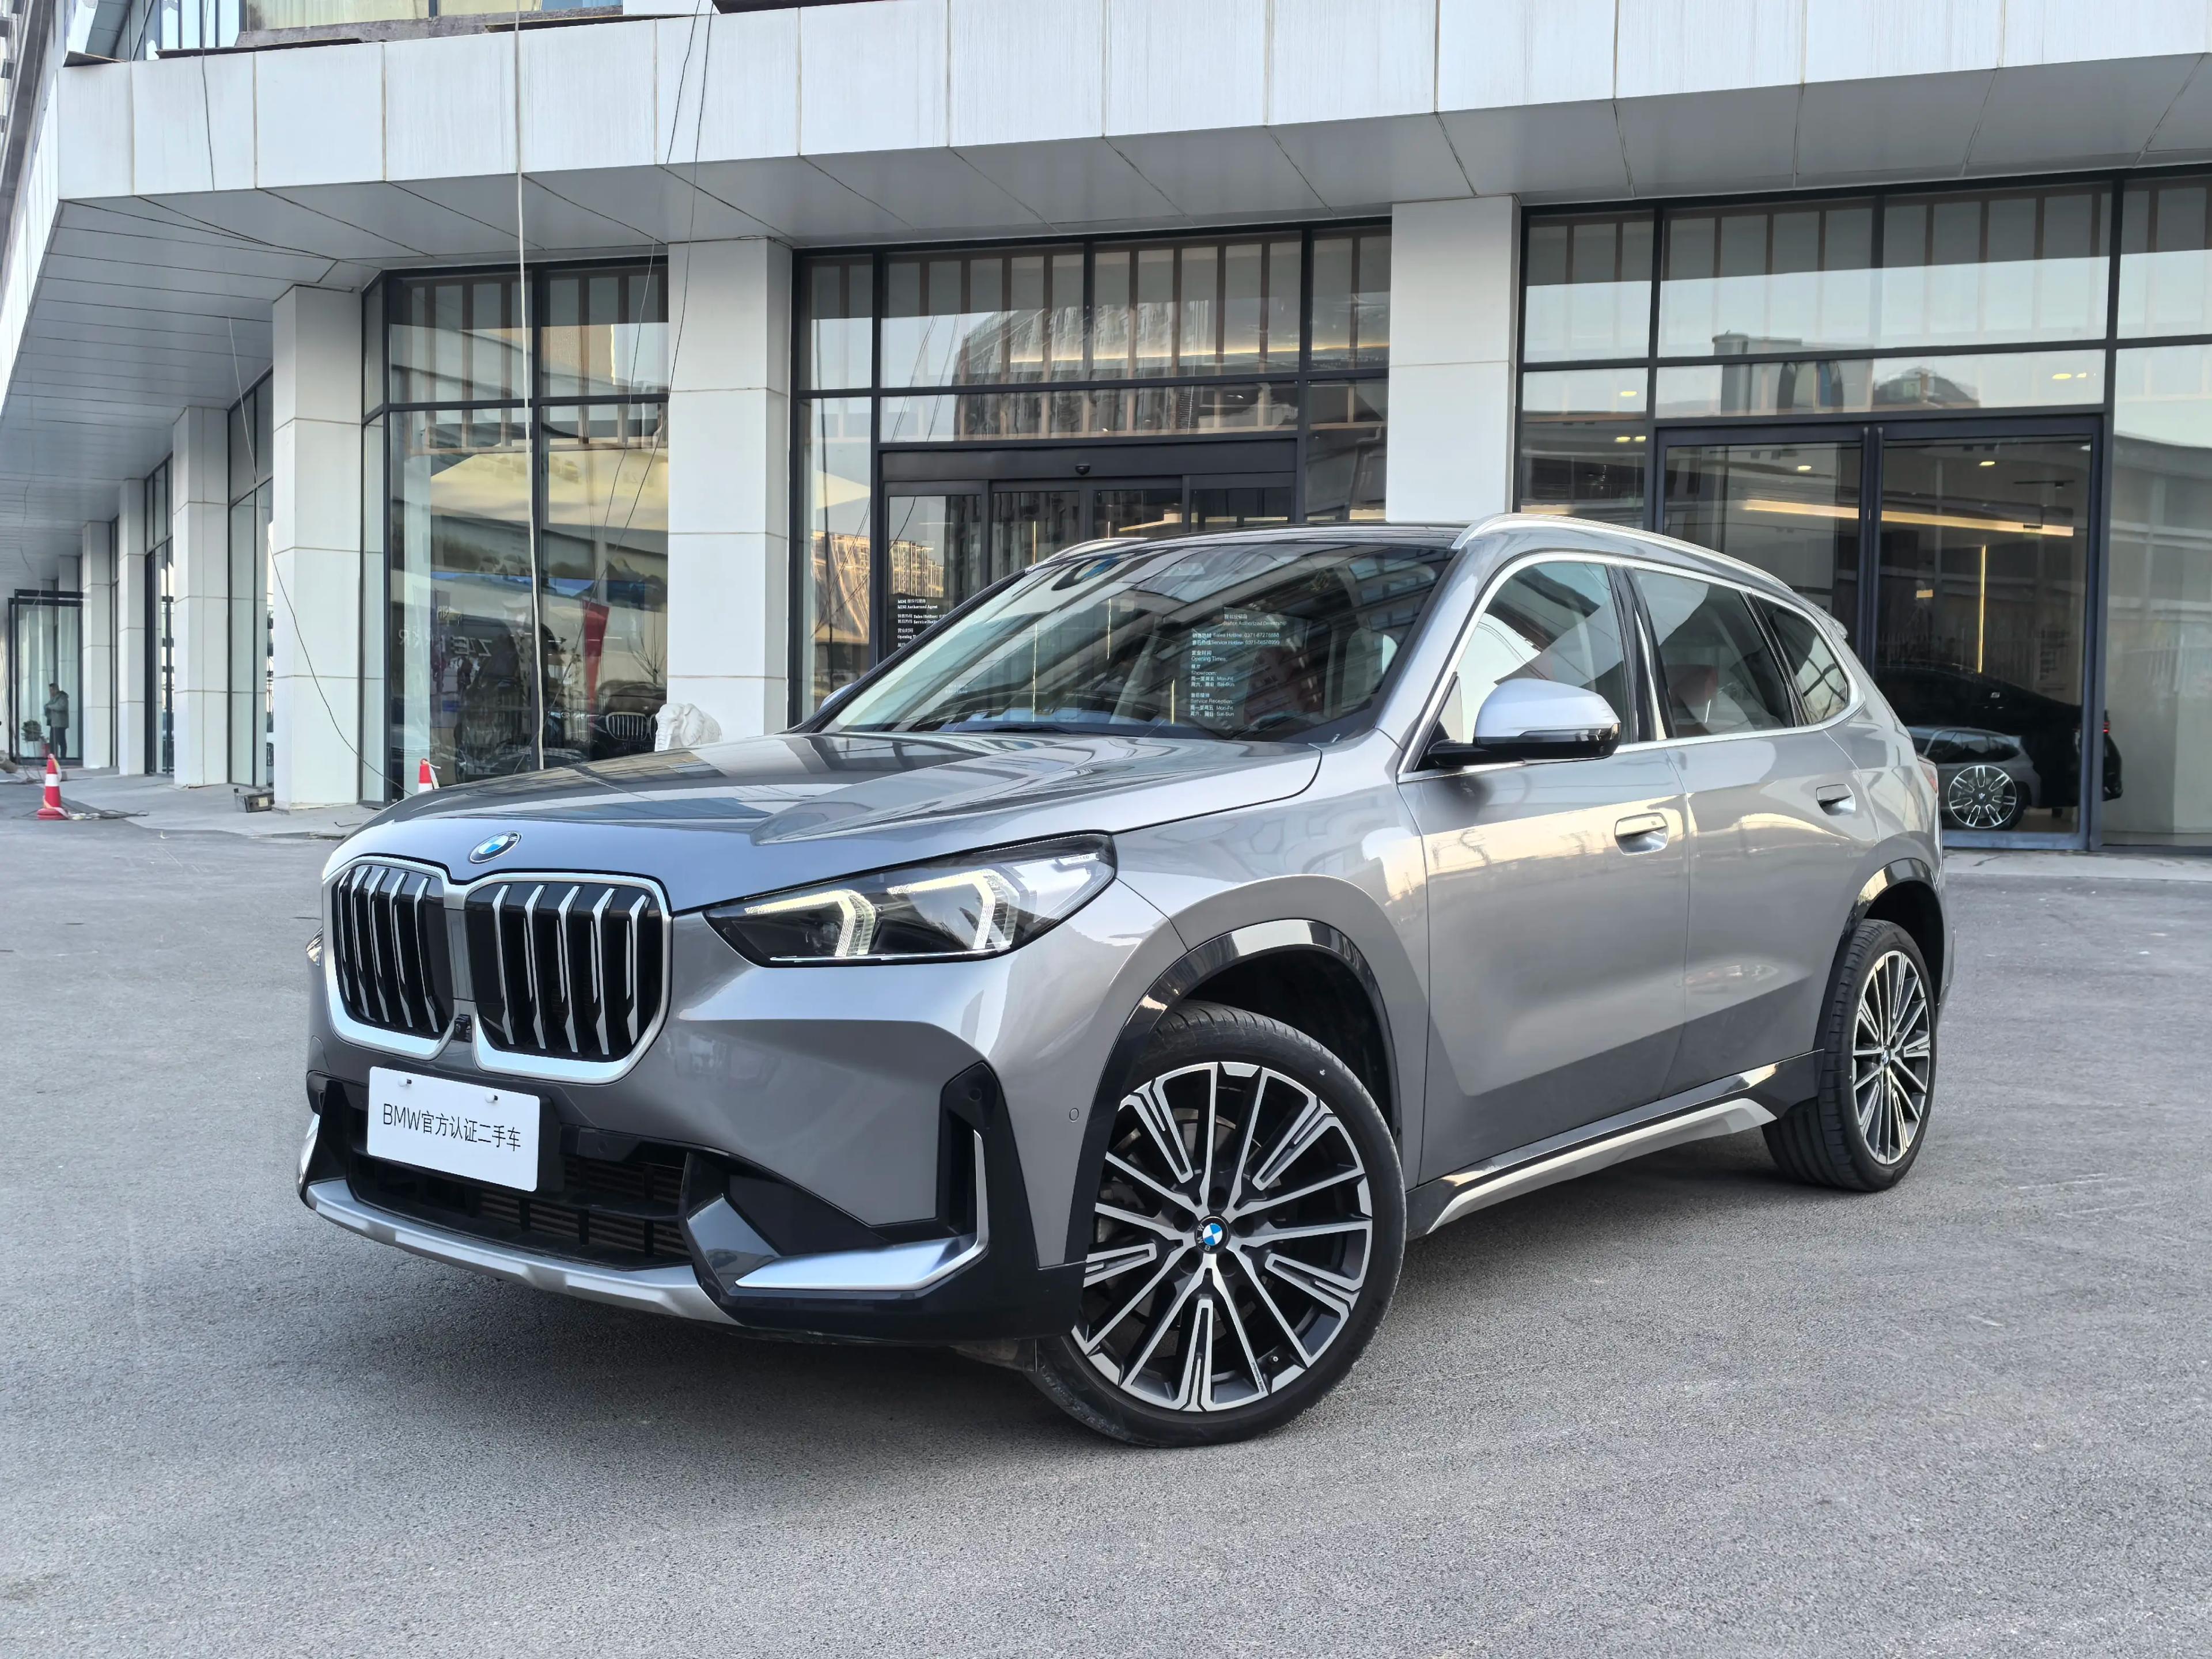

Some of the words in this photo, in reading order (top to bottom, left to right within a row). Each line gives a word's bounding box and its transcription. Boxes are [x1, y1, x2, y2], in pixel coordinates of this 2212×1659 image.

[383, 1103, 521, 1152] BMW官方认证二手车
[1197, 1223, 1211, 1251] BMW
